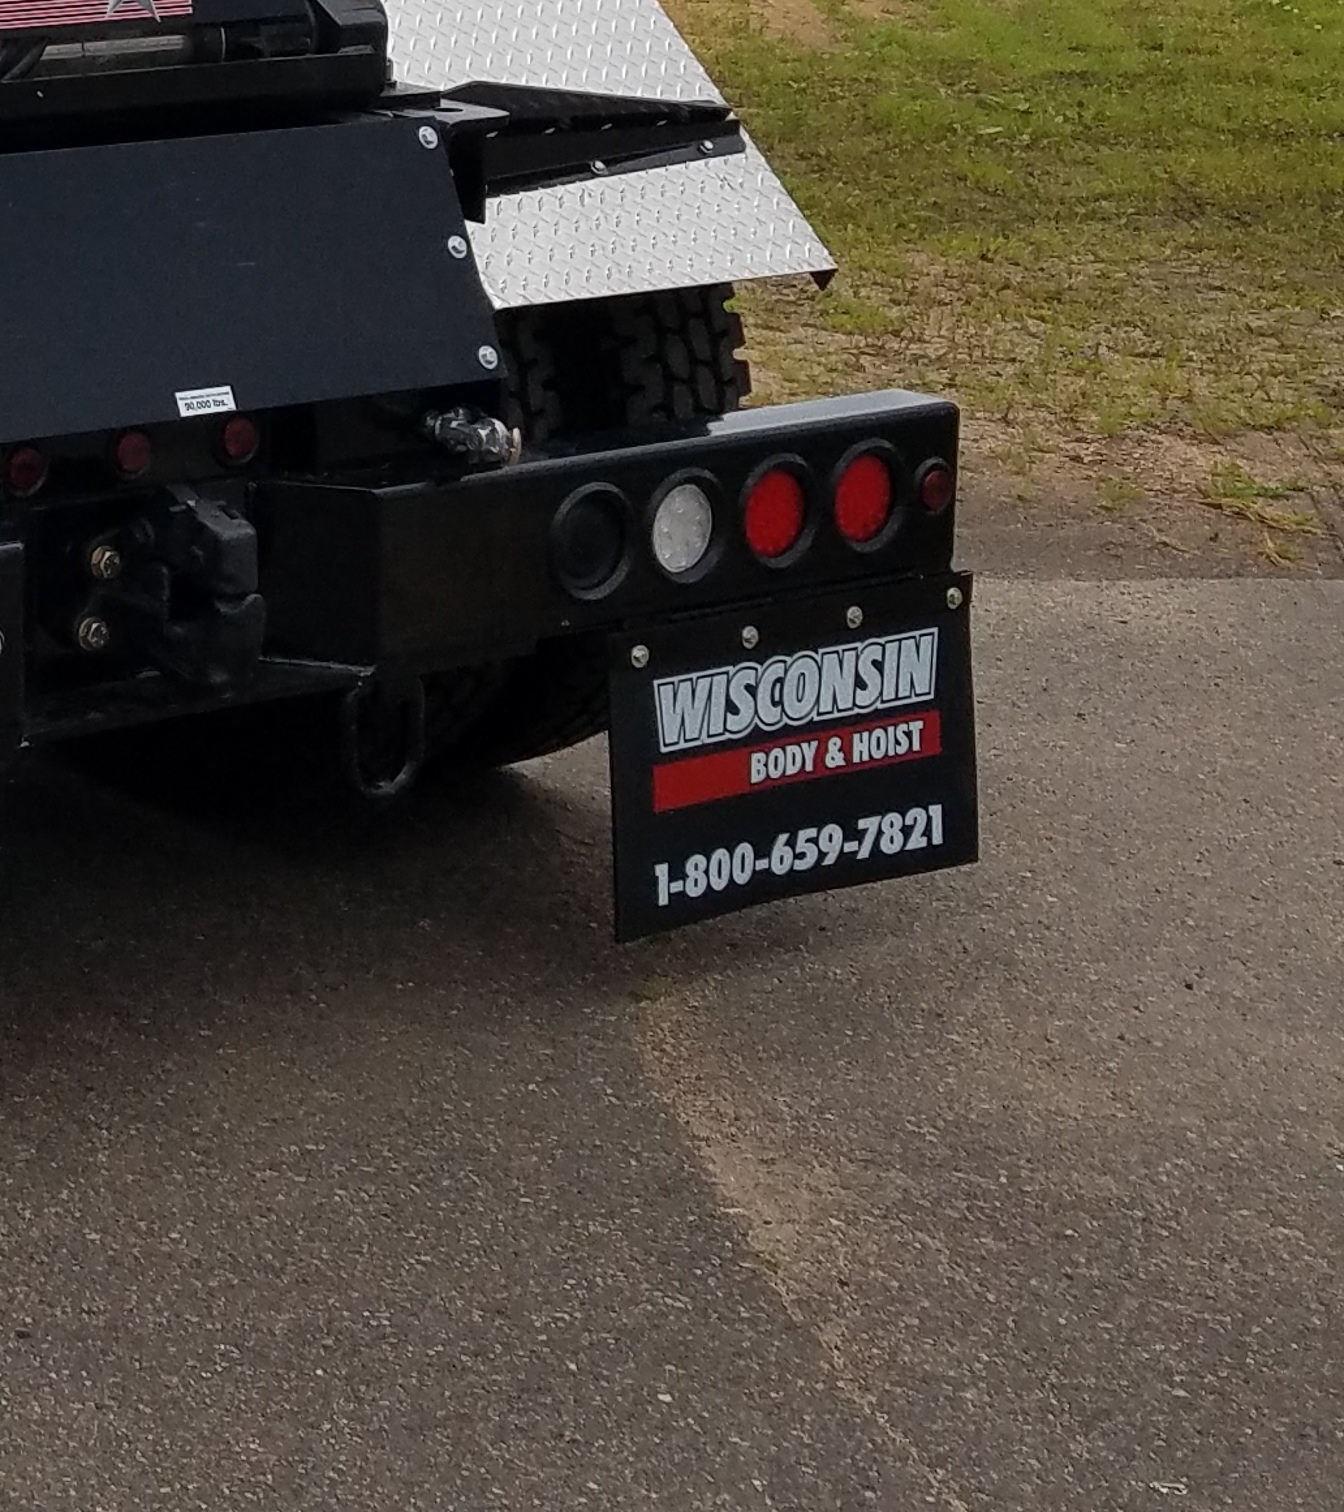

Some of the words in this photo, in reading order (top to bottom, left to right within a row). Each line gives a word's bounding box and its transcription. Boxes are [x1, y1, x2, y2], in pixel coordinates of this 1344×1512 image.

[653, 627, 939, 753] WISCONSIN
[750, 740, 819, 784] BODY
[825, 736, 846, 769] &
[852, 720, 924, 763] HOIST
[654, 804, 944, 907] 1-800-659-7821
